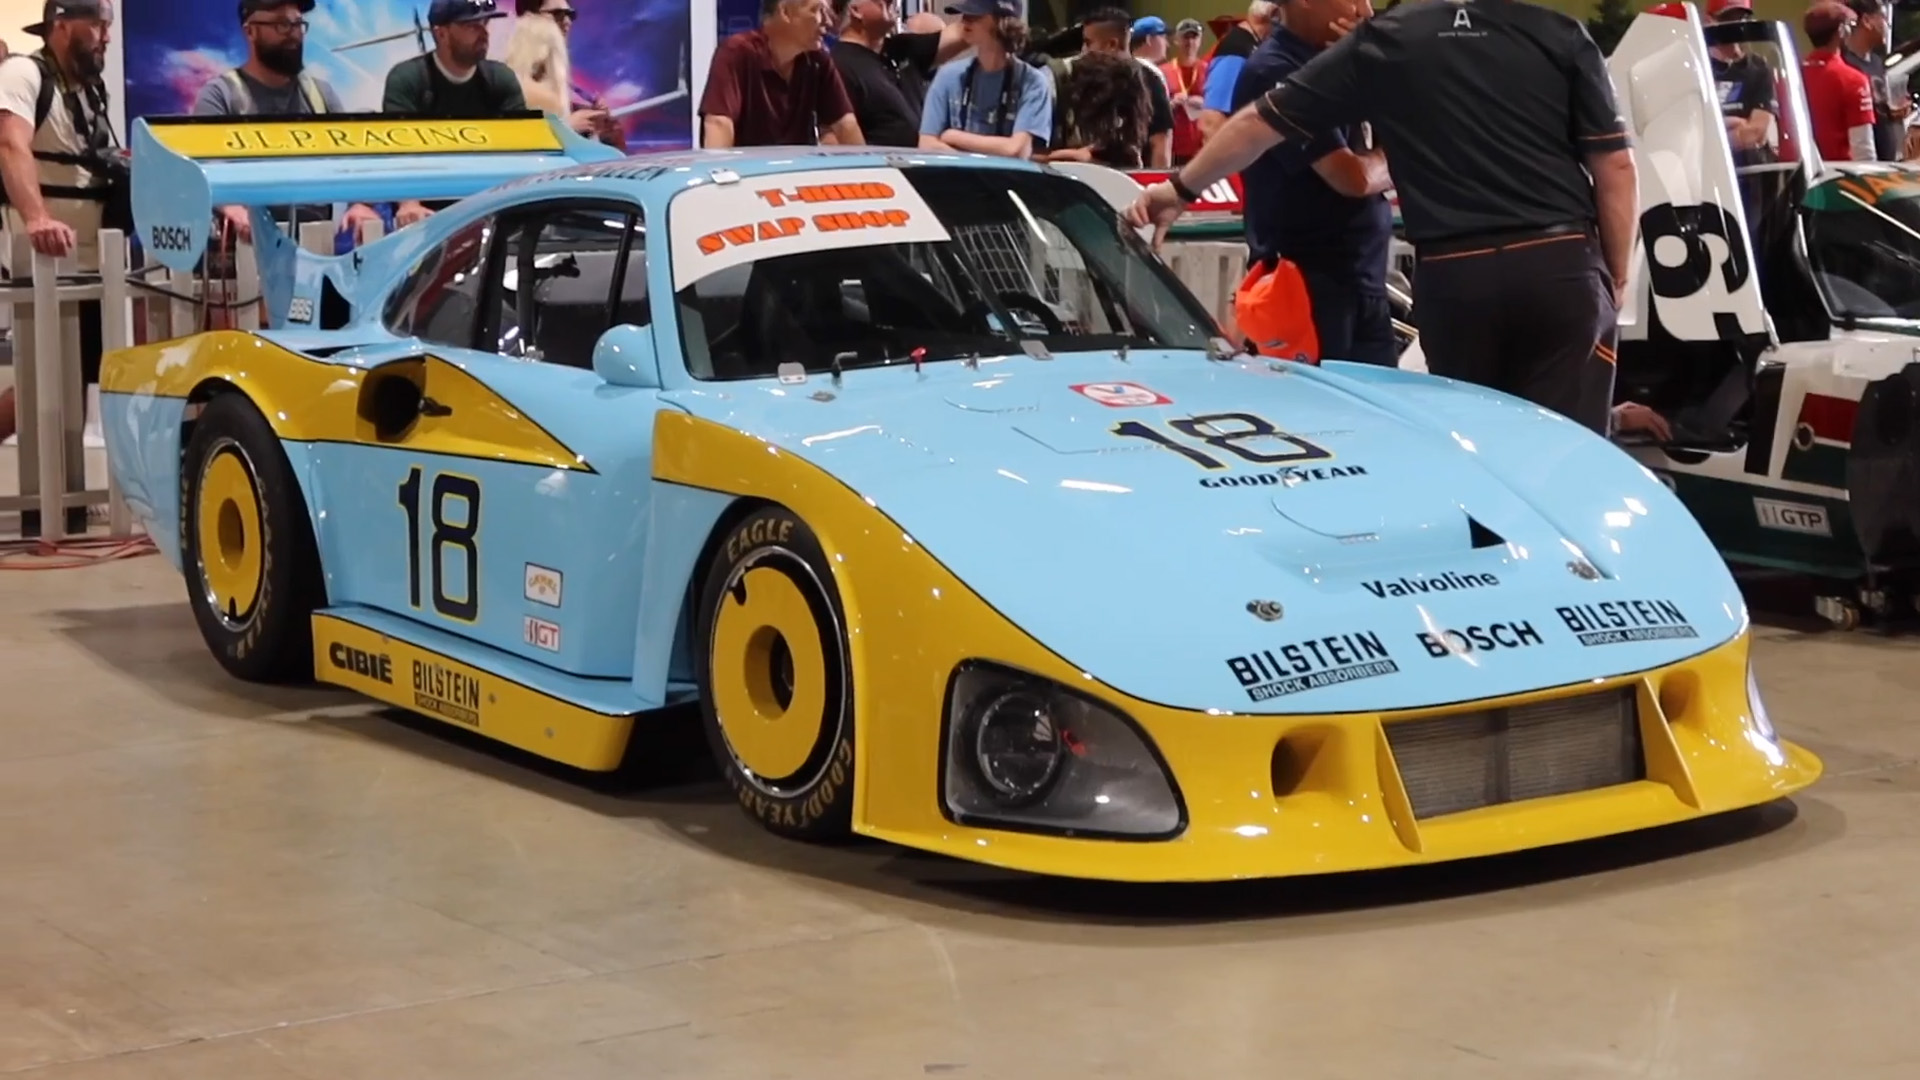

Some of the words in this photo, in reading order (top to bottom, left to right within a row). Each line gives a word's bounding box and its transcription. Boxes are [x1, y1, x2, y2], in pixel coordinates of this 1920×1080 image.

[326, 126, 488, 147] RACING
[152, 225, 192, 251] BOSCH
[696, 217, 806, 255] SWAP
[811, 209, 911, 232] SHOP
[1109, 412, 1336, 470] 18
[1780, 508, 1822, 528] GTP
[397, 464, 482, 624] 18
[727, 518, 794, 563] EAGLE
[1361, 572, 1500, 599] Valvoline
[1555, 599, 1689, 633] BILSTEIN
[1225, 630, 1390, 687] BILSTEIN
[1415, 619, 1544, 659] BOSCH
[1581, 631, 1626, 646] SHOCK
[412, 659, 480, 710] BILSTEIN
[1250, 677, 1311, 701] SHOCK
[1308, 661, 1397, 690] ABSORBERS
